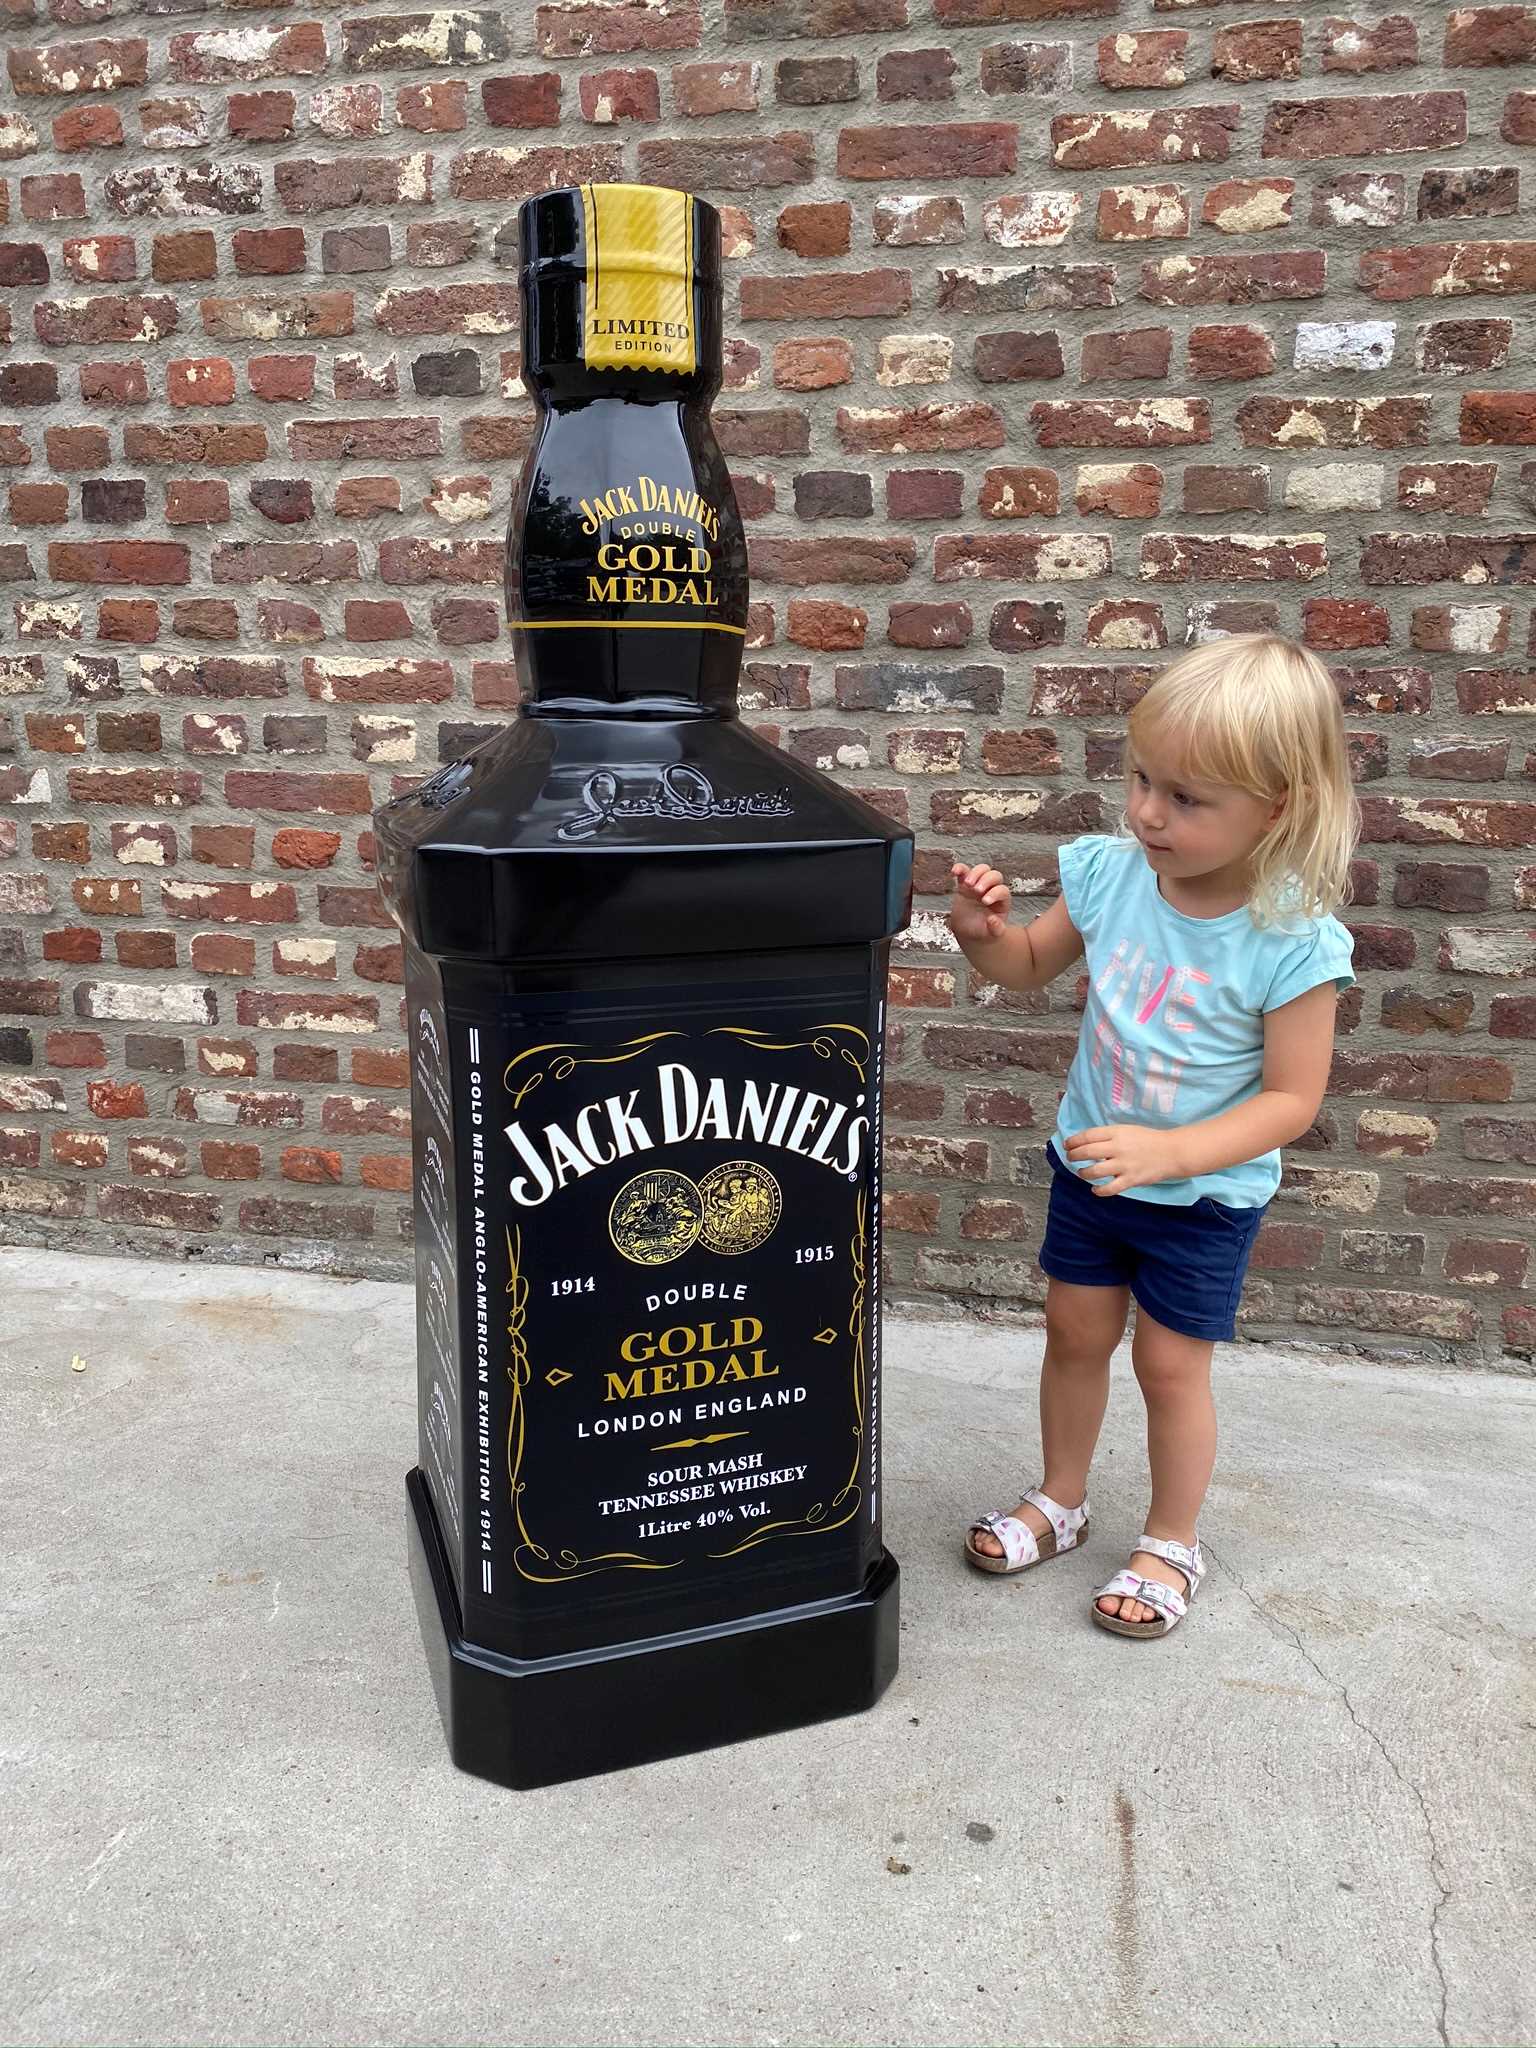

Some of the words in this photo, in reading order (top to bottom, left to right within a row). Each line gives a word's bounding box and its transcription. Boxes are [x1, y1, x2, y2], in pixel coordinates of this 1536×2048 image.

[592, 318, 690, 339] LIMITED
[615, 340, 672, 353] EDITION
[579, 486, 639, 535] JACK
[638, 476, 720, 542] DANIEL'S
[620, 521, 697, 543] DOUBLE
[597, 543, 712, 573] GOLD
[586, 576, 719, 606] MEDAL
[470, 1071, 483, 1126] GOLD
[503, 1089, 654, 1207] JACK
[657, 1063, 871, 1176] DANIEL'S
[472, 1133, 486, 1199] MEDAL
[873, 1175, 879, 1198] OF
[795, 1245, 834, 1264] 1915
[474, 1206, 489, 1383] ANGLO-AMERICAN
[551, 1276, 596, 1297] 1914
[645, 1282, 748, 1312] DOUBLE
[621, 1317, 763, 1363] GOLD
[604, 1349, 780, 1402] MEDAL
[578, 1408, 682, 1438] LONDON
[696, 1387, 807, 1420] ENGLAND
[478, 1389, 491, 1502] EXHIBITION
[647, 1464, 704, 1488] SOUR
[707, 1452, 763, 1477] MASH
[598, 1482, 716, 1516] TENNESSEE
[719, 1464, 808, 1495] WHISKEY
[480, 1509, 492, 1551] 1914
[697, 1508, 734, 1528] 40%
[738, 1500, 771, 1519] Vol.
